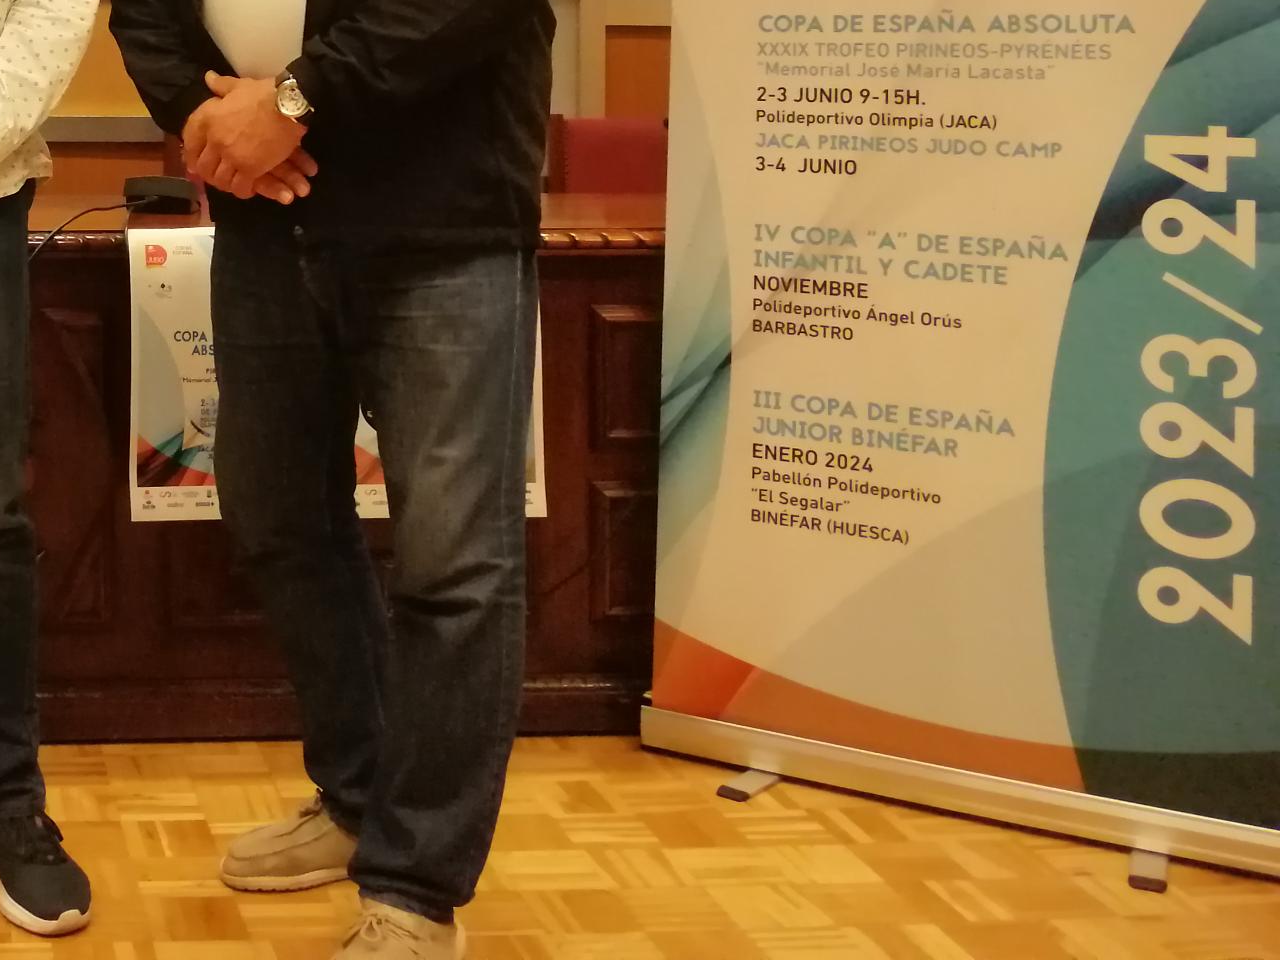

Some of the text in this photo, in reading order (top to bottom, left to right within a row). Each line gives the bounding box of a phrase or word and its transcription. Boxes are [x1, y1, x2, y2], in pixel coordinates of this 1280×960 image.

[759, 9, 1136, 34] COPA DE ESPAÑA ABSOLUTA
[757, 42, 809, 57] XXXIX
[815, 43, 889, 58] TROFEO
[857, 62, 960, 79] José María
[757, 87, 926, 105] 2-3 JUNIO 9-15H.
[756, 110, 997, 130] Polideportivo Olimpia (JACA)
[756, 133, 1062, 158] JACA PIRINEOS JUDO CAMP
[756, 157, 857, 175] 3-4 JUNIO
[754, 224, 1068, 261] IV COPA DE ESPAÑA
[754, 249, 1008, 285] INFANTIL Y CADETE
[753, 275, 868, 298] NOVIEMBRE
[753, 299, 962, 329] Polideportivo Ángel Orús
[174, 331, 208, 342] COPA
[752, 320, 854, 341] BARBASTRO
[1137, 125, 1264, 645] 2023/24
[753, 390, 1015, 437] III COPA DE ESPAÑA
[753, 416, 958, 458] JUNIOR BINÉFAR
[752, 443, 873, 473] ENERO 2024
[752, 467, 941, 504] Pabellón Polideportivo
[751, 508, 909, 544] BINÉFAR (HUESCA)
